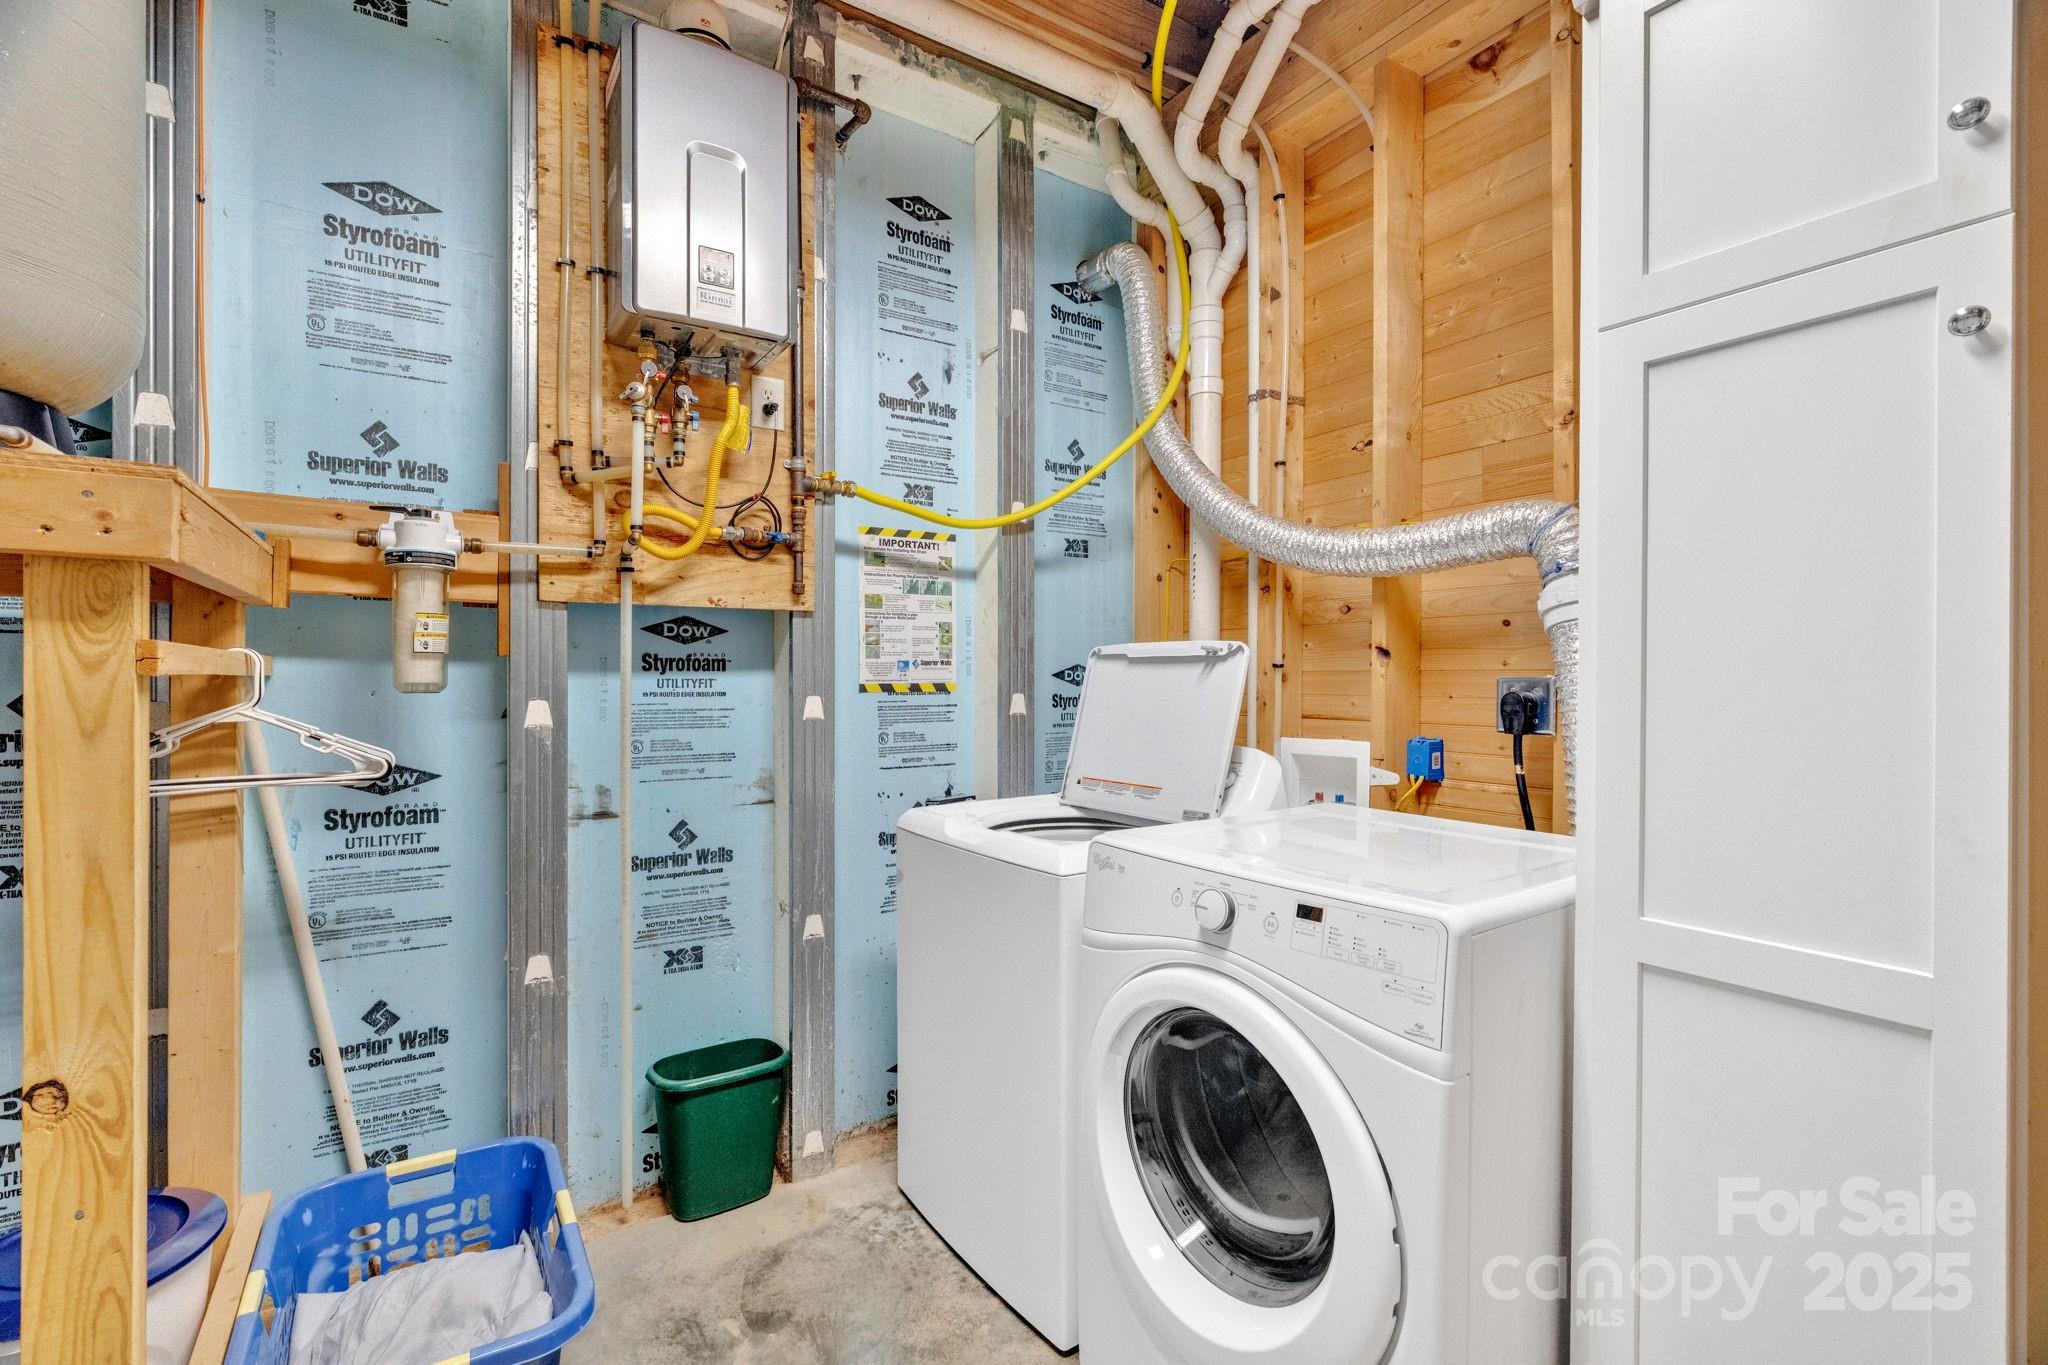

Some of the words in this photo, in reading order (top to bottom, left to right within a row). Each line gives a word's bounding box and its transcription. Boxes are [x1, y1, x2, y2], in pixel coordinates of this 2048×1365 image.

[353, 184, 421, 212] DOW
[903, 199, 938, 219] DOW
[323, 214, 440, 258] Styrofoam
[887, 221, 951, 253] Styrofoam
[344, 247, 424, 273] UTILITYFIT
[899, 245, 942, 265] UTILITYFIT
[333, 261, 347, 269] PSI
[347, 264, 377, 276] ROUTED
[377, 269, 397, 280] EDGE
[397, 272, 440, 288] INSULATION
[928, 263, 951, 275] INSULATION
[700, 292, 732, 305] Rinnai
[1062, 285, 1093, 301] DOW
[1051, 304, 1102, 331] Styrofoam
[1060, 326, 1095, 341] UTILITYFIT
[878, 392, 925, 414] Superior
[928, 401, 957, 420] Walls
[307, 450, 392, 477] Superior
[398, 459, 449, 483] Walls
[1045, 459, 1081, 476] Superior
[329, 477, 435, 494] www.superiorwalls.com
[879, 538, 940, 550] IMPORTANT!
[663, 623, 711, 637] DOW
[642, 653, 727, 675] Styrofoam
[657, 678, 713, 689] UTILITYFIT
[1064, 670, 1085, 680] DO
[1052, 693, 1080, 710] Styro
[324, 806, 440, 833] Styrofoam
[345, 833, 423, 849] UTILITYFIT
[348, 851, 377, 860] ROUTED
[378, 850, 397, 858] EDGE
[398, 846, 440, 856] INSULATION
[631, 852, 692, 872] Superior
[696, 847, 734, 865] Walls
[646, 868, 723, 881] www.superiorwalls.com
[399, 1027, 449, 1050] Walls
[373, 1111, 400, 1123] Builder
[409, 1105, 436, 1114] Owner:
[404, 1112, 427, 1122] Superior
[427, 1114, 447, 1123] details.
